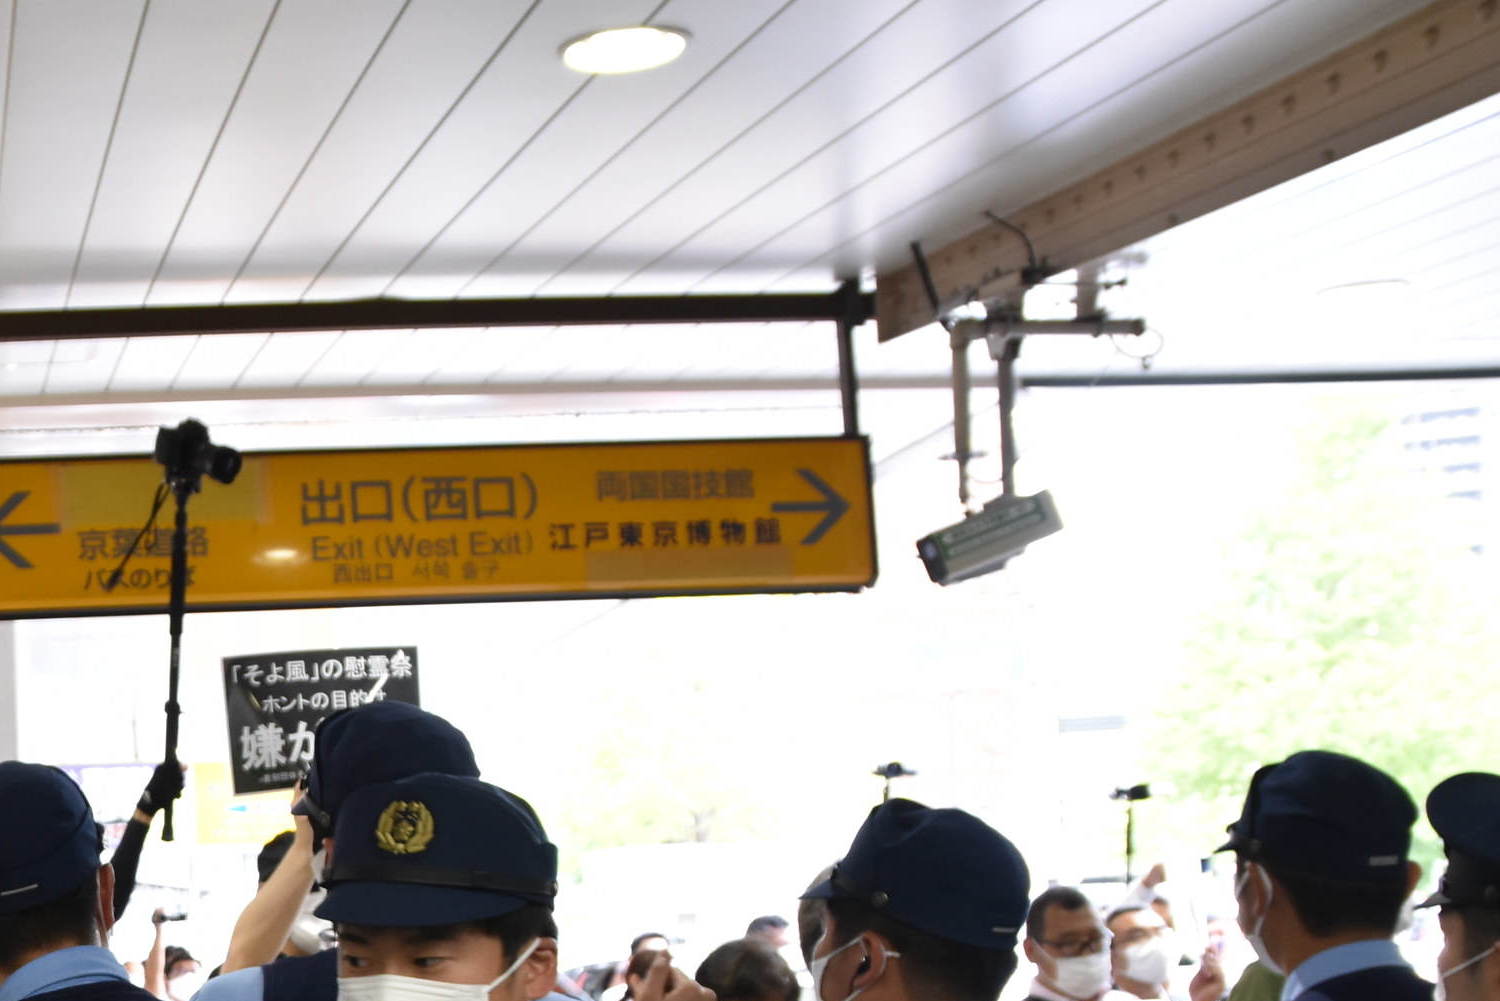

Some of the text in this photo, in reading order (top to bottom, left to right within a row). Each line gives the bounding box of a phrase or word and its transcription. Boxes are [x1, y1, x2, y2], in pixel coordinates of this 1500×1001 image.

[301, 472, 539, 526] 出口(西口)
[596, 468, 755, 502] 両国国技館
[311, 530, 534, 562] Exit (West Exit)
[549, 517, 782, 550] 江戸東京博物館
[231, 652, 412, 686] 「そよ風」の慰霊祭
